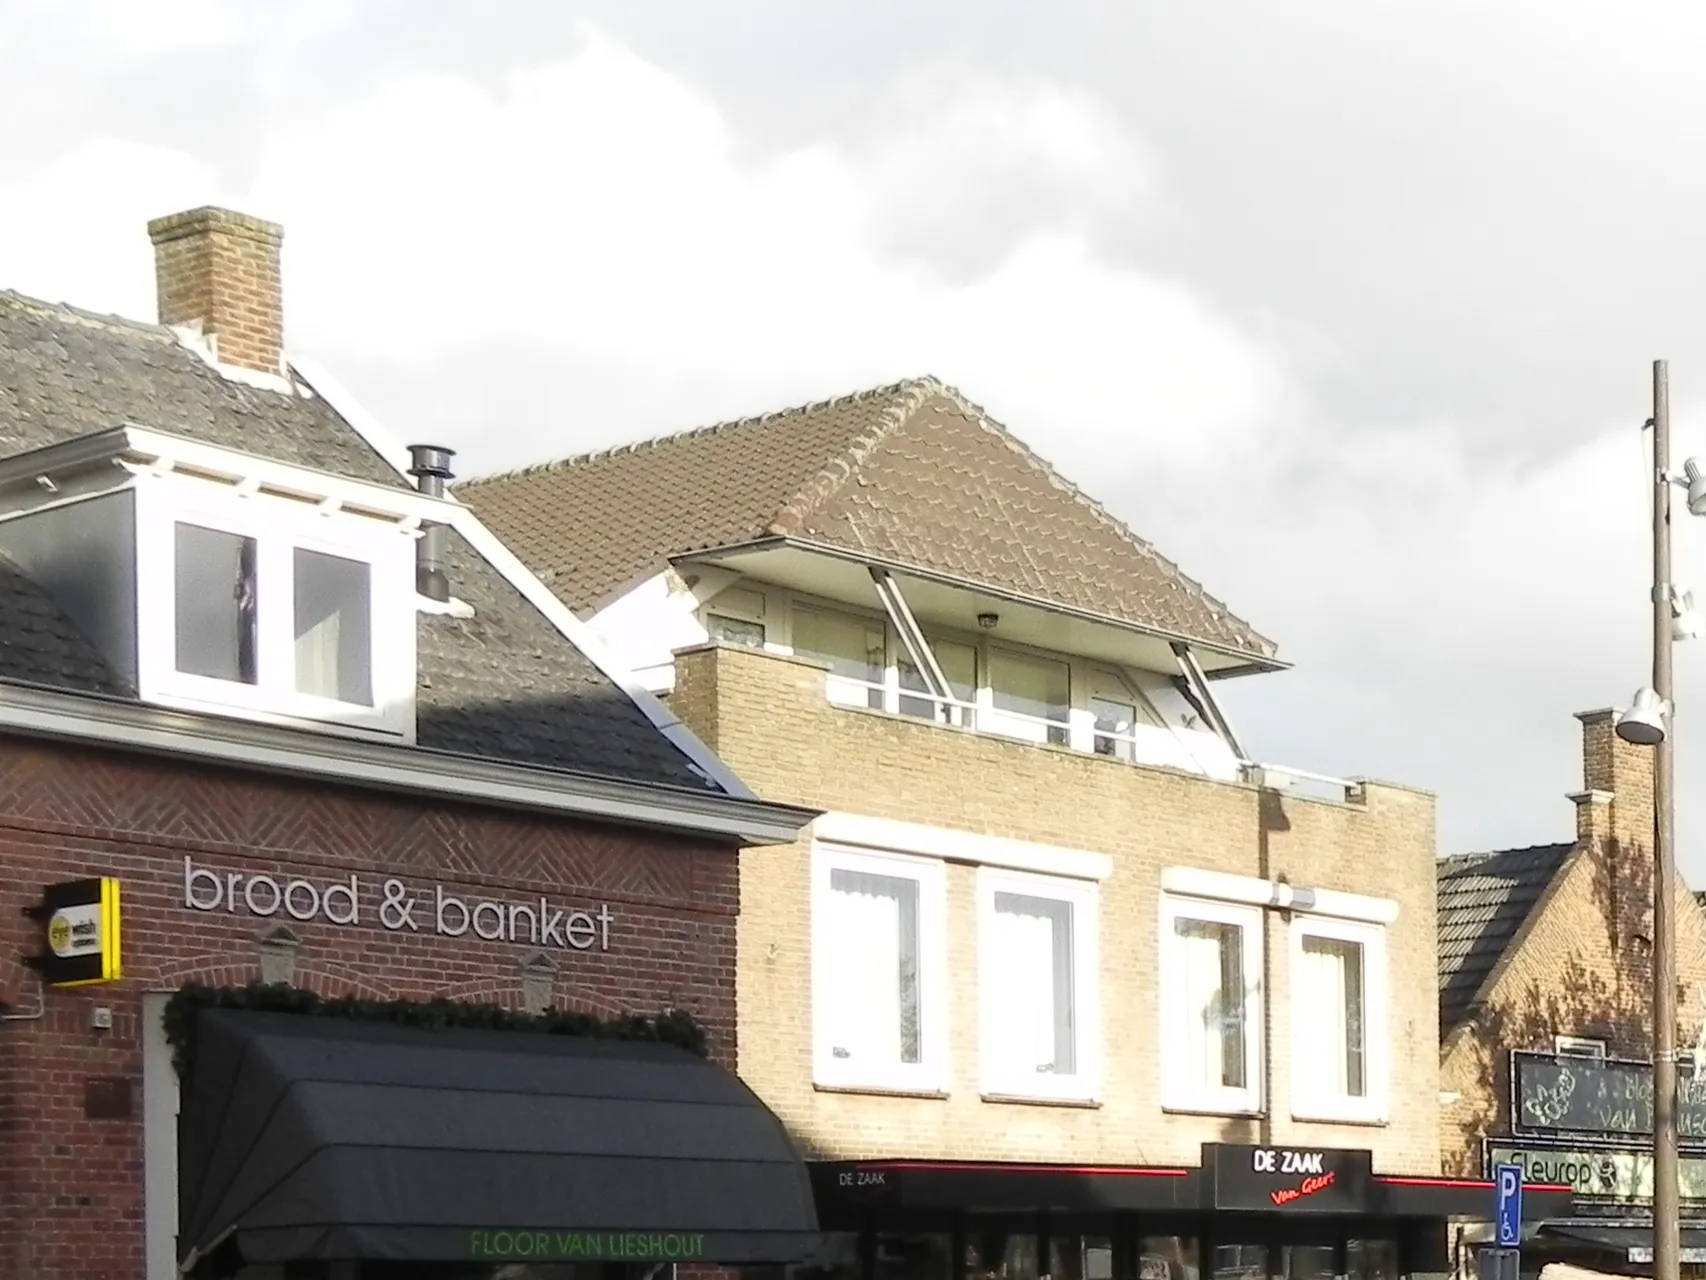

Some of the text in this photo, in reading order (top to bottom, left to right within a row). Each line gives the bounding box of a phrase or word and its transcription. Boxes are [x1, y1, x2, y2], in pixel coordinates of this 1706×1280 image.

[184, 855, 614, 951] brood & banket
[1254, 1150, 1323, 1174] DE ZAAK
[839, 1171, 886, 1186] DE ZAAK
[1502, 1171, 1516, 1210] P
[1271, 1189, 1300, 1205] Van
[471, 1231, 704, 1257] FLOOR VAN LIESHOUT
